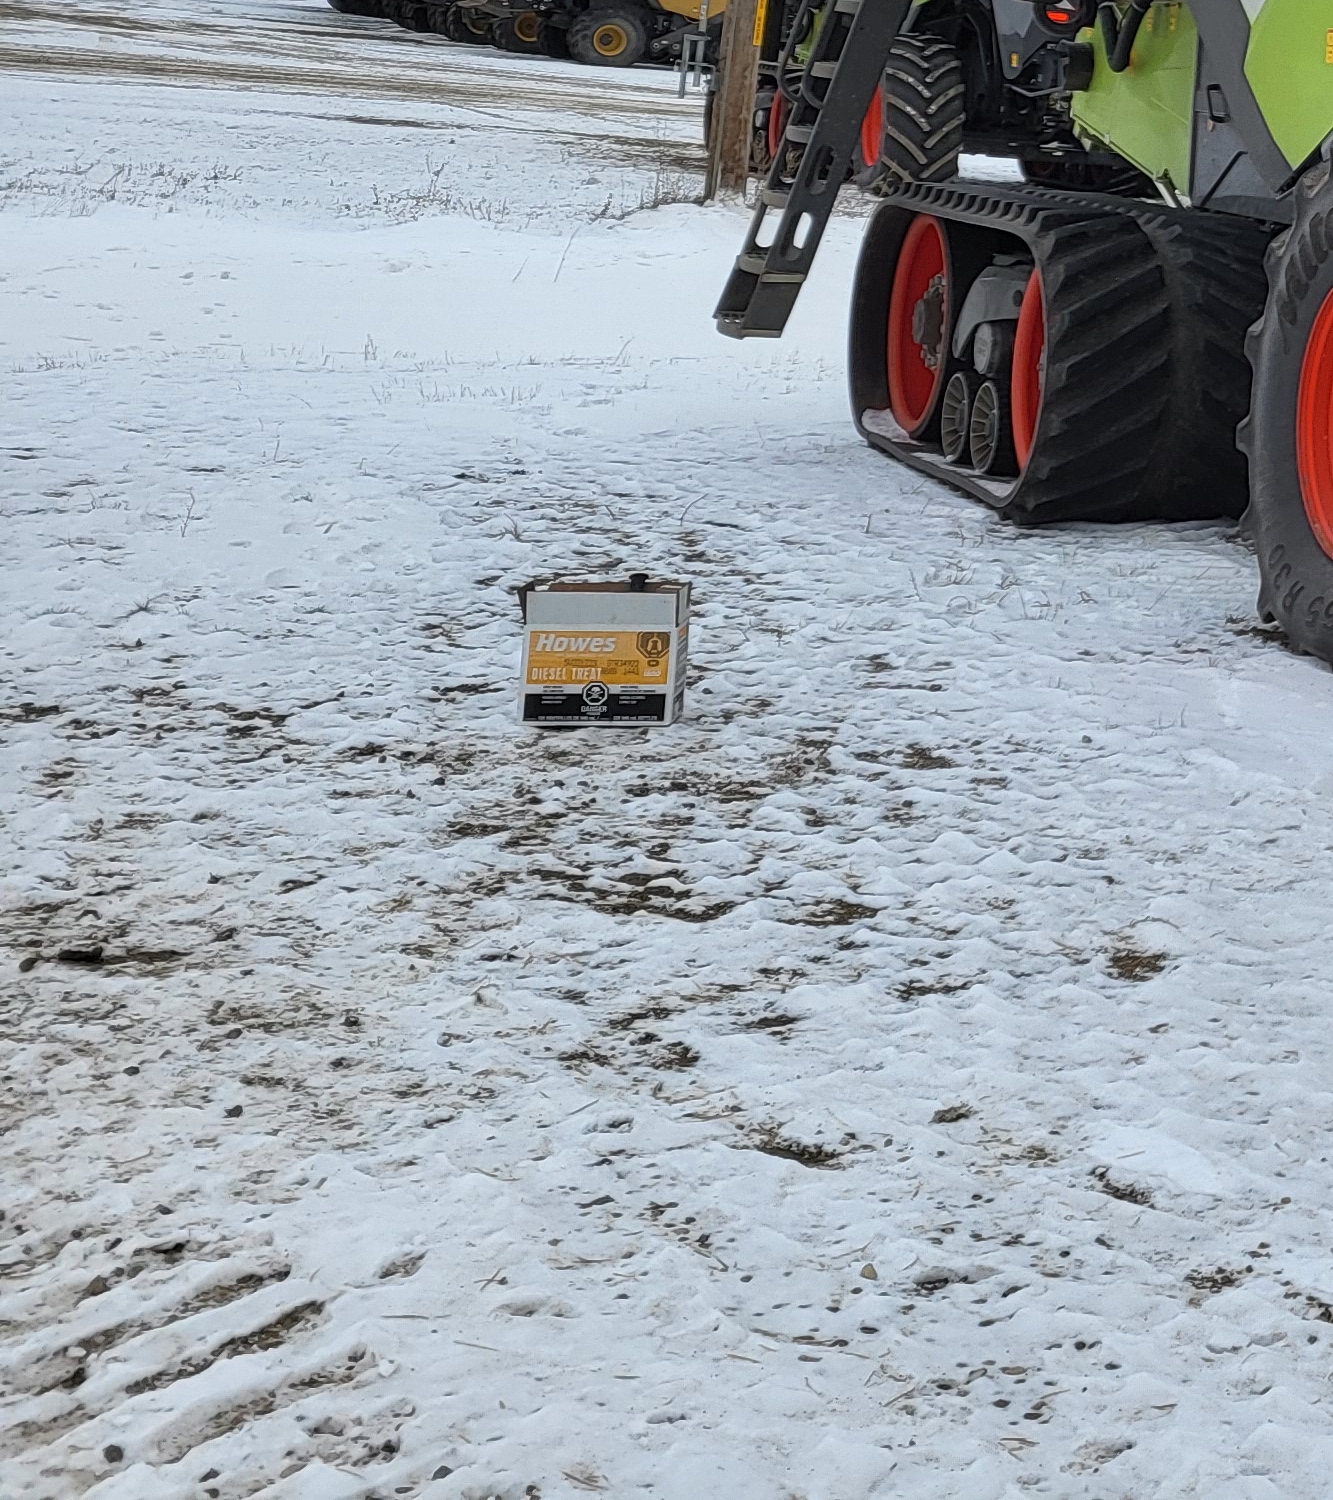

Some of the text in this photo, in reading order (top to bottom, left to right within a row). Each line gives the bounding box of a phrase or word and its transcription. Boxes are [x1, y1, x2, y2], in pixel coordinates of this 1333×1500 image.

[535, 633, 617, 652] Howes
[531, 667, 567, 681] DIESEL
[571, 667, 602, 680] TREAT
